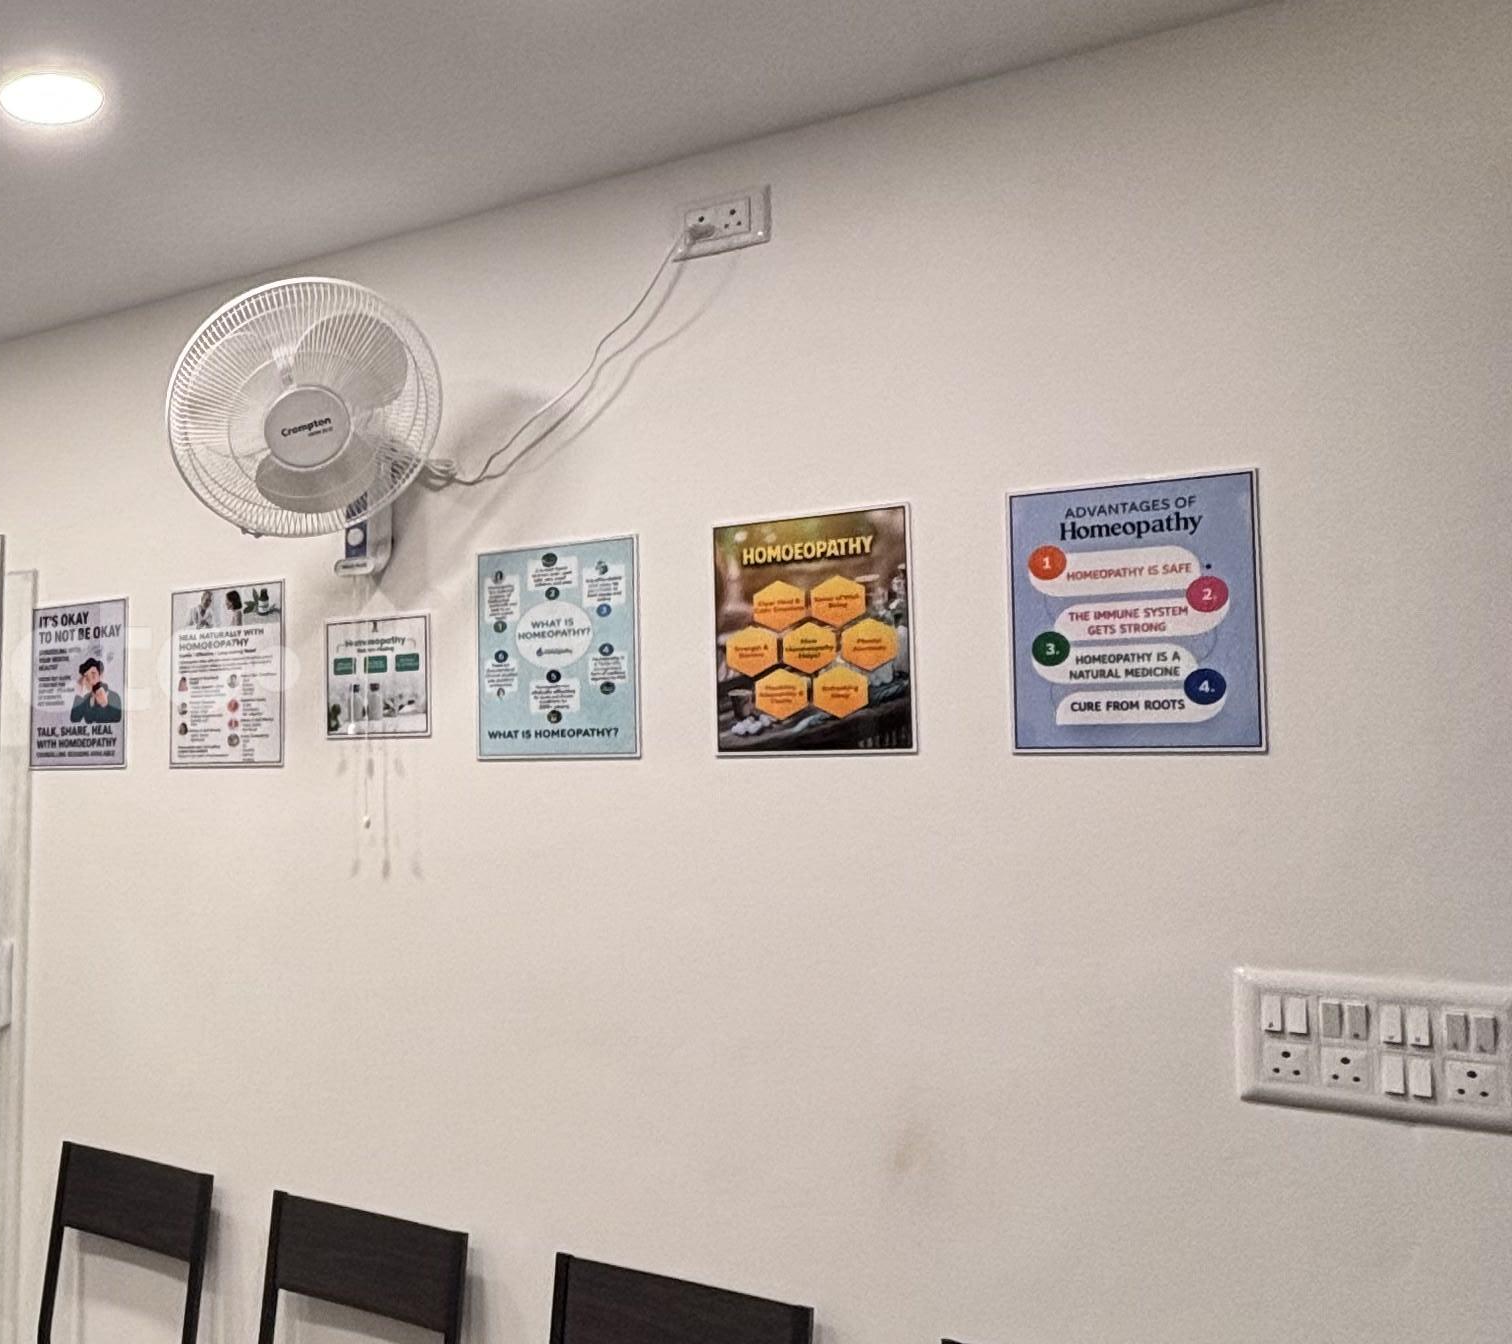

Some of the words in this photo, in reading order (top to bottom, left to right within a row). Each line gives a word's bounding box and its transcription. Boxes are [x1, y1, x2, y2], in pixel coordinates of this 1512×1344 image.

[281, 417, 331, 437] Crompton
[1065, 498, 1170, 519] ADVANTAGES
[1174, 495, 1197, 509] OF
[1060, 511, 1203, 541] Homeopathy
[742, 535, 874, 566] HOMOEOPATHY
[1067, 567, 1146, 581] HOMEOPATHY
[1148, 565, 1160, 575] IS
[1162, 562, 1192, 574] SAFE
[39, 615, 58, 629] IT'S
[61, 611, 89, 626] OKAY
[1069, 611, 1090, 622] THE
[1094, 608, 1139, 620] IMMUNE
[1144, 606, 1188, 618] SYSTEM
[531, 618, 562, 629] WHAT
[565, 617, 574, 626] IS
[1088, 623, 1116, 635] GETS
[1120, 622, 1166, 634] STRONG
[39, 631, 52, 644] TO
[55, 629, 76, 642] NOT
[78, 627, 90, 640] BE
[93, 624, 122, 639] OKAY
[199, 629, 242, 639] NATURALLY
[243, 628, 264, 637] WITH
[518, 628, 591, 640] HOMEOPATHY?
[179, 638, 249, 652] HOMOEOPATHY
[1075, 652, 1153, 665] HOMEOPATHY
[1157, 652, 1168, 662] IS
[1172, 651, 1181, 661] A
[1069, 668, 1121, 680] NATURAL
[1125, 666, 1180, 678] MEDICINE
[1071, 702, 1102, 712] CURE
[1106, 701, 1139, 711] FROM
[1144, 699, 1186, 711] ROOTS
[37, 727, 59, 738] TALK,
[61, 726, 90, 737] SHARE,
[92, 725, 113, 735] HEAL
[488, 729, 519, 739] WHAT
[522, 729, 532, 739] IS
[535, 727, 619, 739] HOMEOPATHY?
[37, 739, 57, 749] WITH
[58, 737, 118, 748] HOMOEOPATHY
